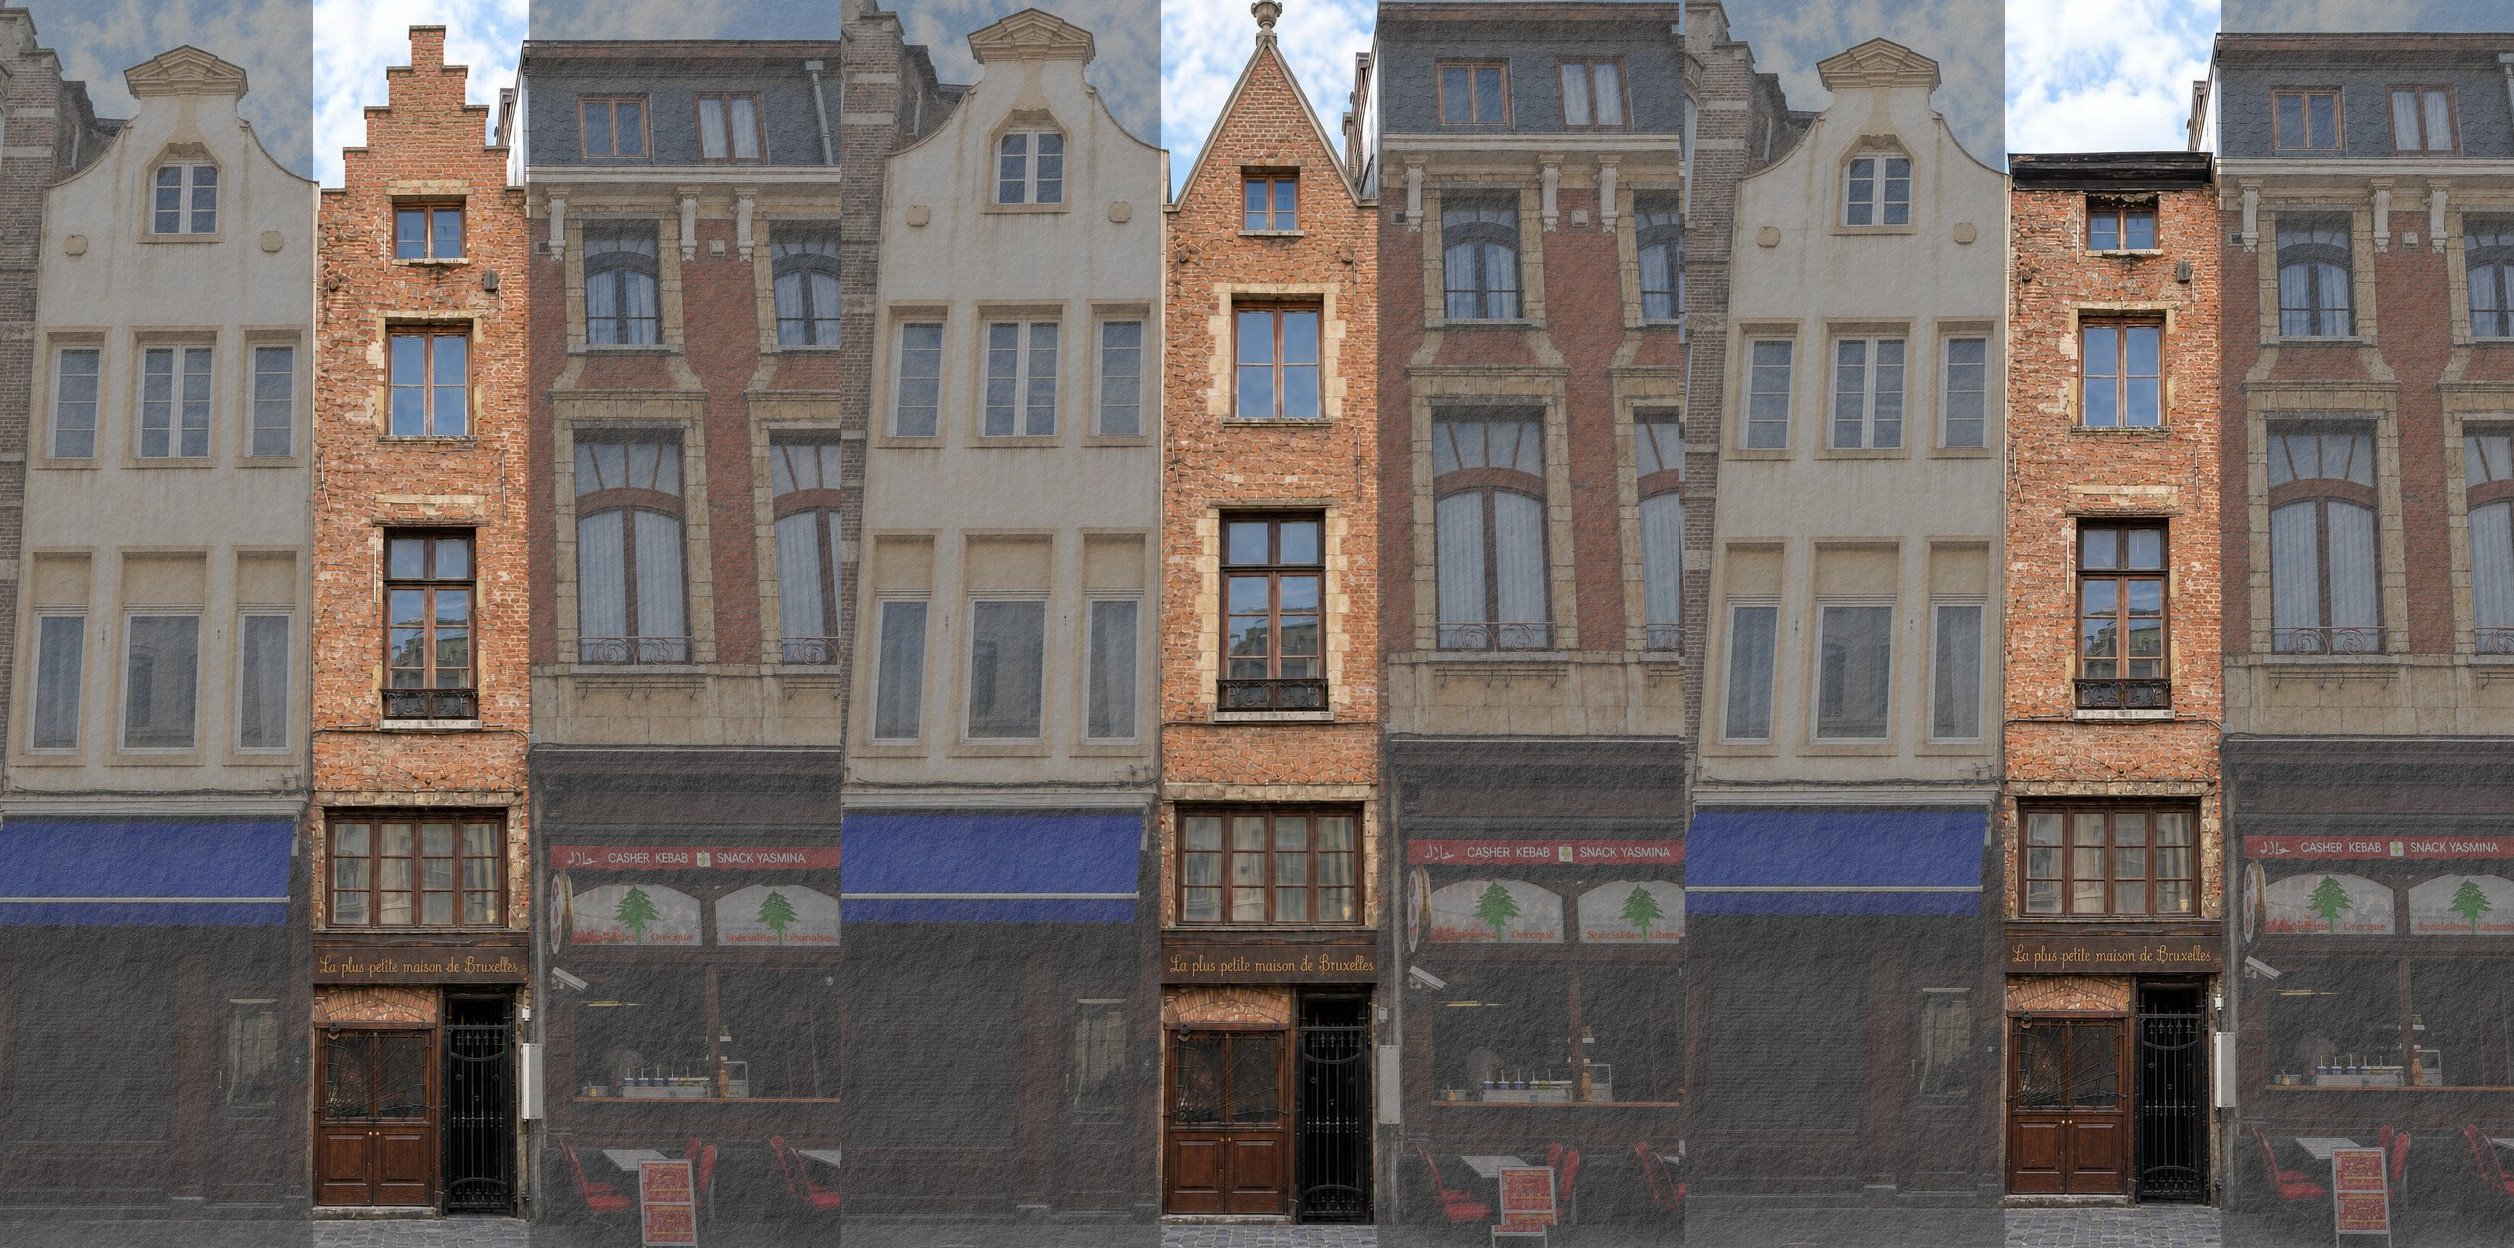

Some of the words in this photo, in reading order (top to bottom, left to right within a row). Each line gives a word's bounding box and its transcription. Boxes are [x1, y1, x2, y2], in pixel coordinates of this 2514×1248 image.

[1467, 846, 1511, 858] CASHER
[1516, 846, 1551, 858] KEBAB
[1580, 846, 1618, 858] SNACK
[1620, 846, 1671, 858] YASMINA
[2300, 841, 2343, 854] CASHER
[2348, 841, 2382, 853] KEBAB
[2410, 841, 2447, 853] SNACK
[2449, 841, 2500, 853] YASMINA
[607, 852, 650, 864] CASHER
[655, 852, 689, 864] KEBAB
[717, 852, 754, 864] SNACK
[756, 852, 807, 864] YASMINA
[1169, 954, 1188, 973] La
[1192, 955, 1216, 977] plus
[1219, 956, 1250, 977] petite
[1255, 958, 1295, 972] maison
[1300, 954, 1313, 972] de
[1318, 953, 1374, 975] Bruxelles
[2012, 943, 2029, 962] La
[2034, 945, 2057, 969] plus
[2062, 947, 2090, 969] petite
[2096, 948, 2136, 962] maison
[2140, 946, 2152, 962] de
[2157, 944, 2211, 965] Bruxelles
[319, 954, 337, 973] La
[341, 955, 364, 978] plus
[368, 957, 398, 978] petite
[403, 959, 442, 973] maison
[446, 956, 460, 973] de
[464, 955, 518, 976] Bruxelles
